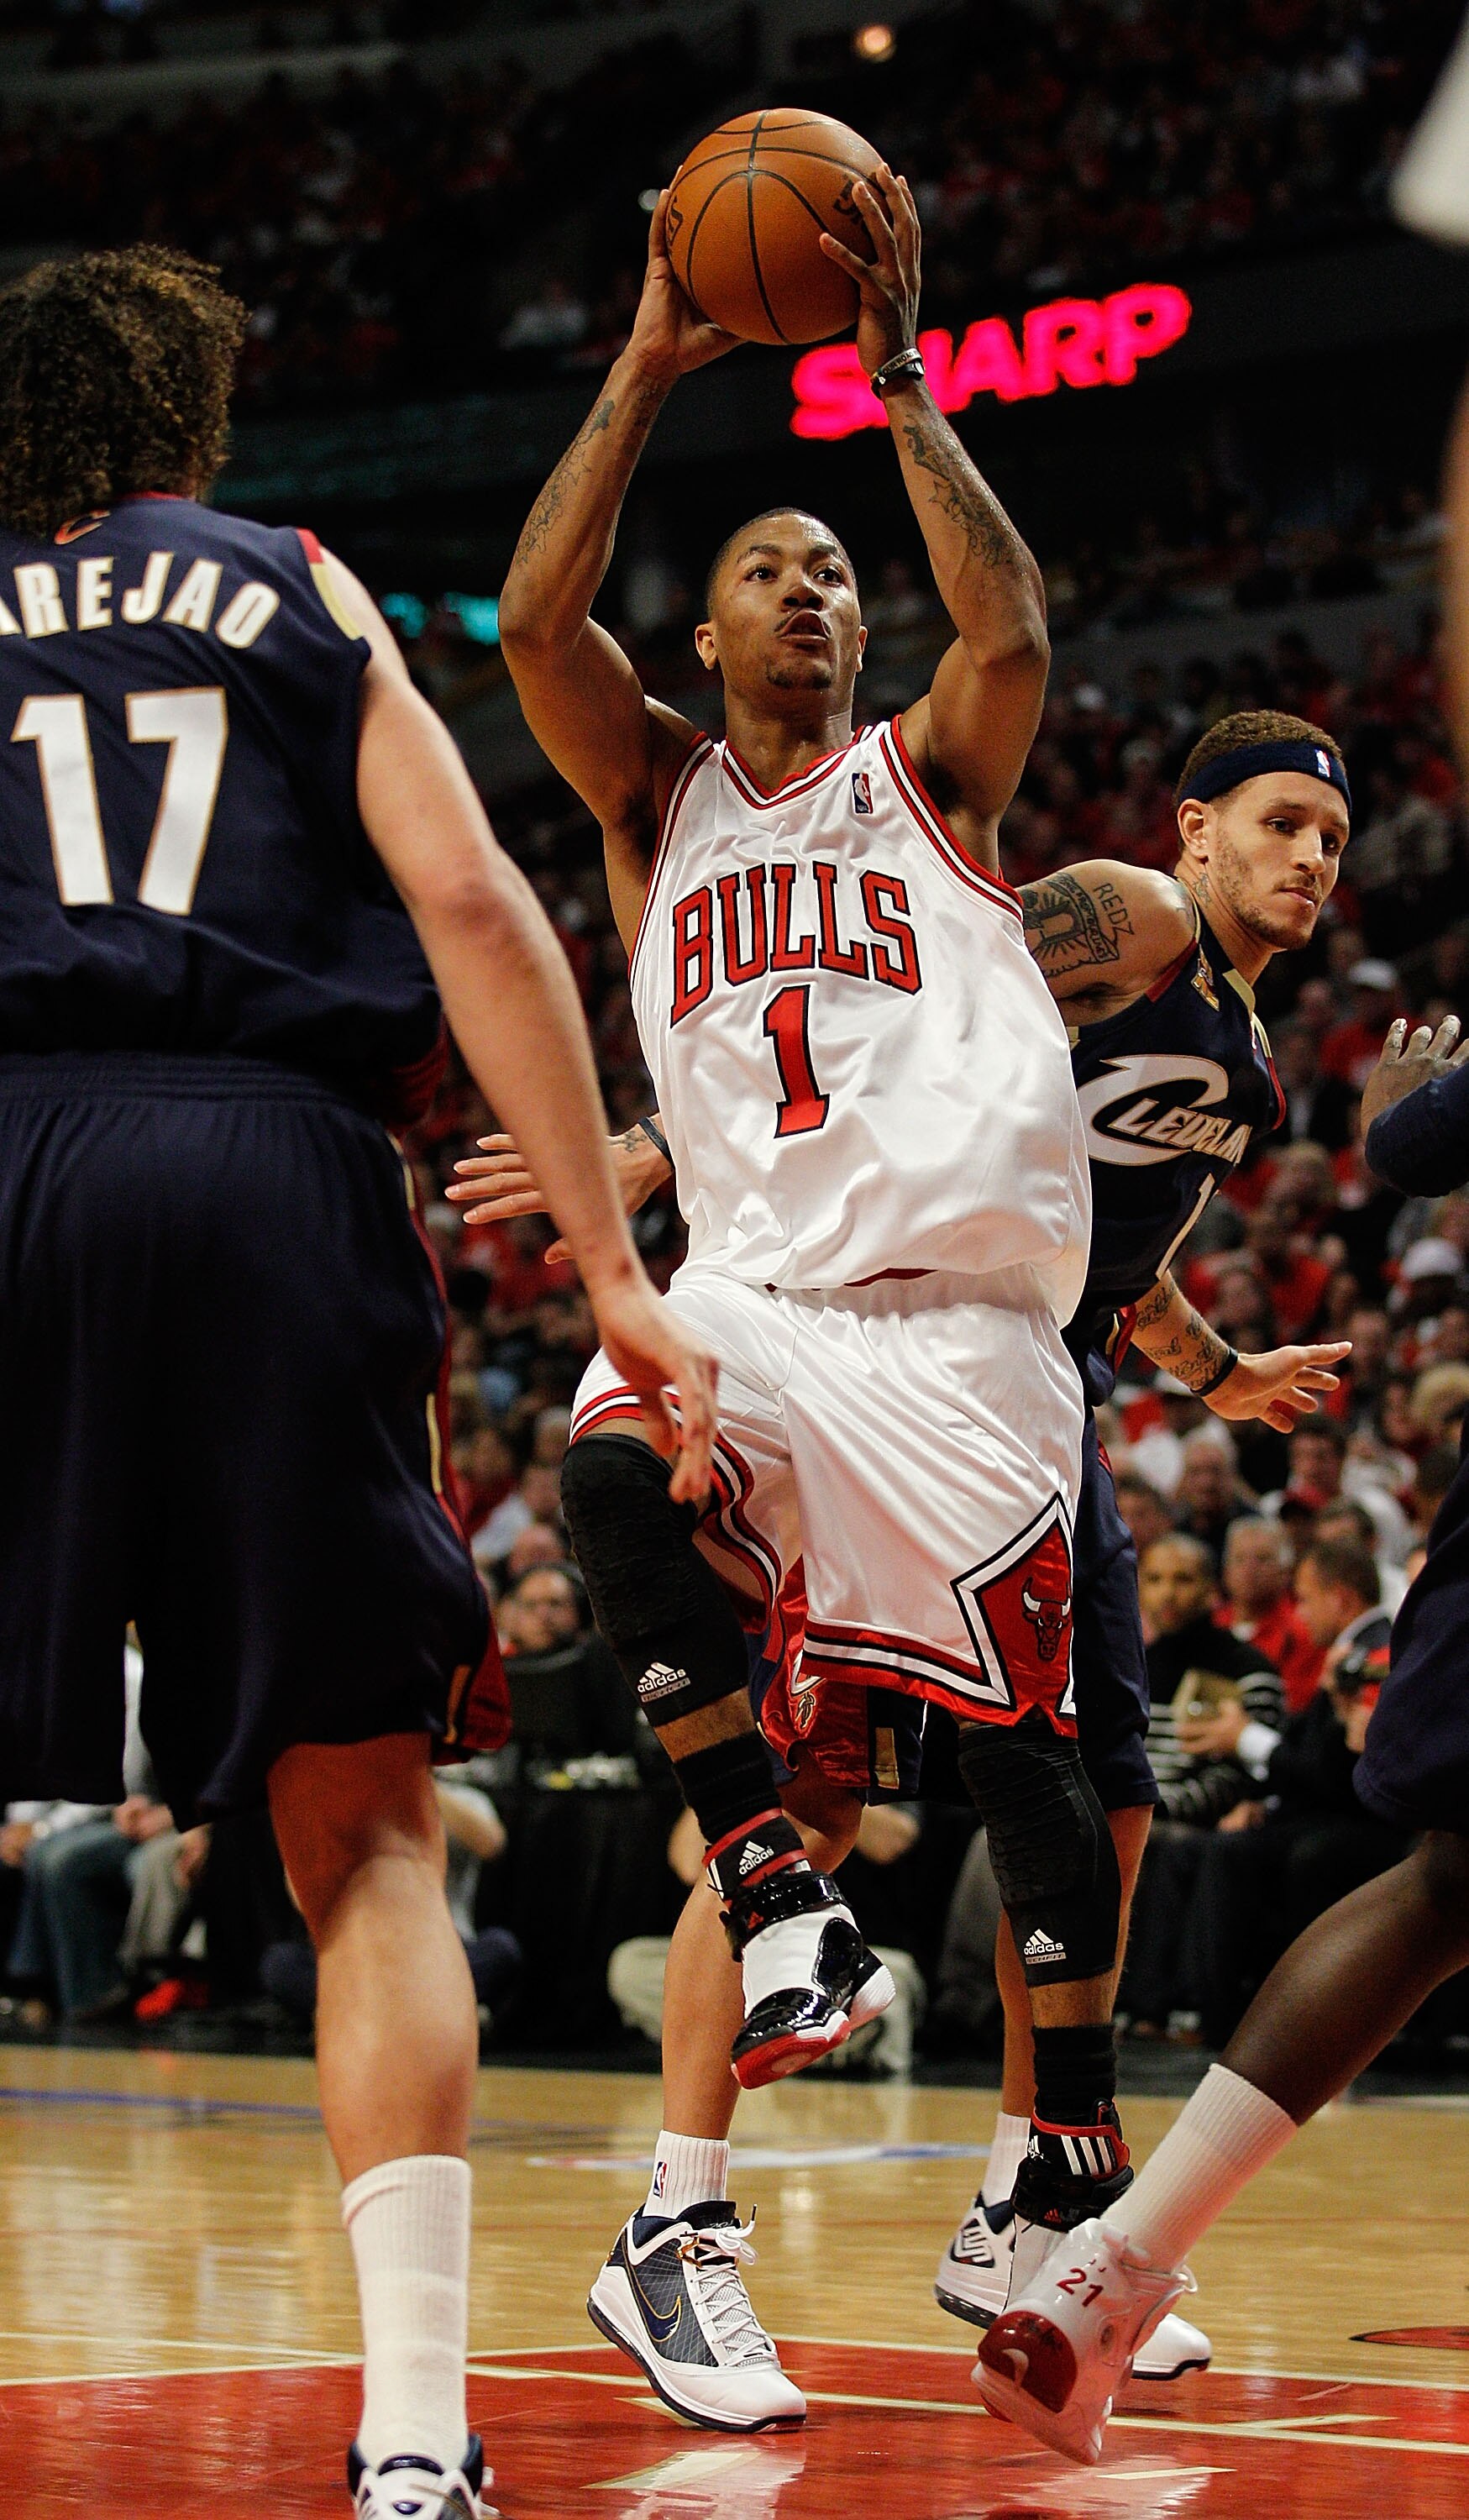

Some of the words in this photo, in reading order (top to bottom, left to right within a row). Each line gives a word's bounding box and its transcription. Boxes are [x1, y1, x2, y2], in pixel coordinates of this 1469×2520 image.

[10, 685, 228, 916] 17
[1093, 883, 1136, 946] REDZ
[670, 861, 923, 1029] BULLS
[764, 984, 831, 1139] 1
[637, 1668, 686, 1693] adidas
[738, 1848, 774, 1876] adidas
[1024, 1942, 1064, 1956] adidas
[1056, 2267, 1104, 2307] 21
